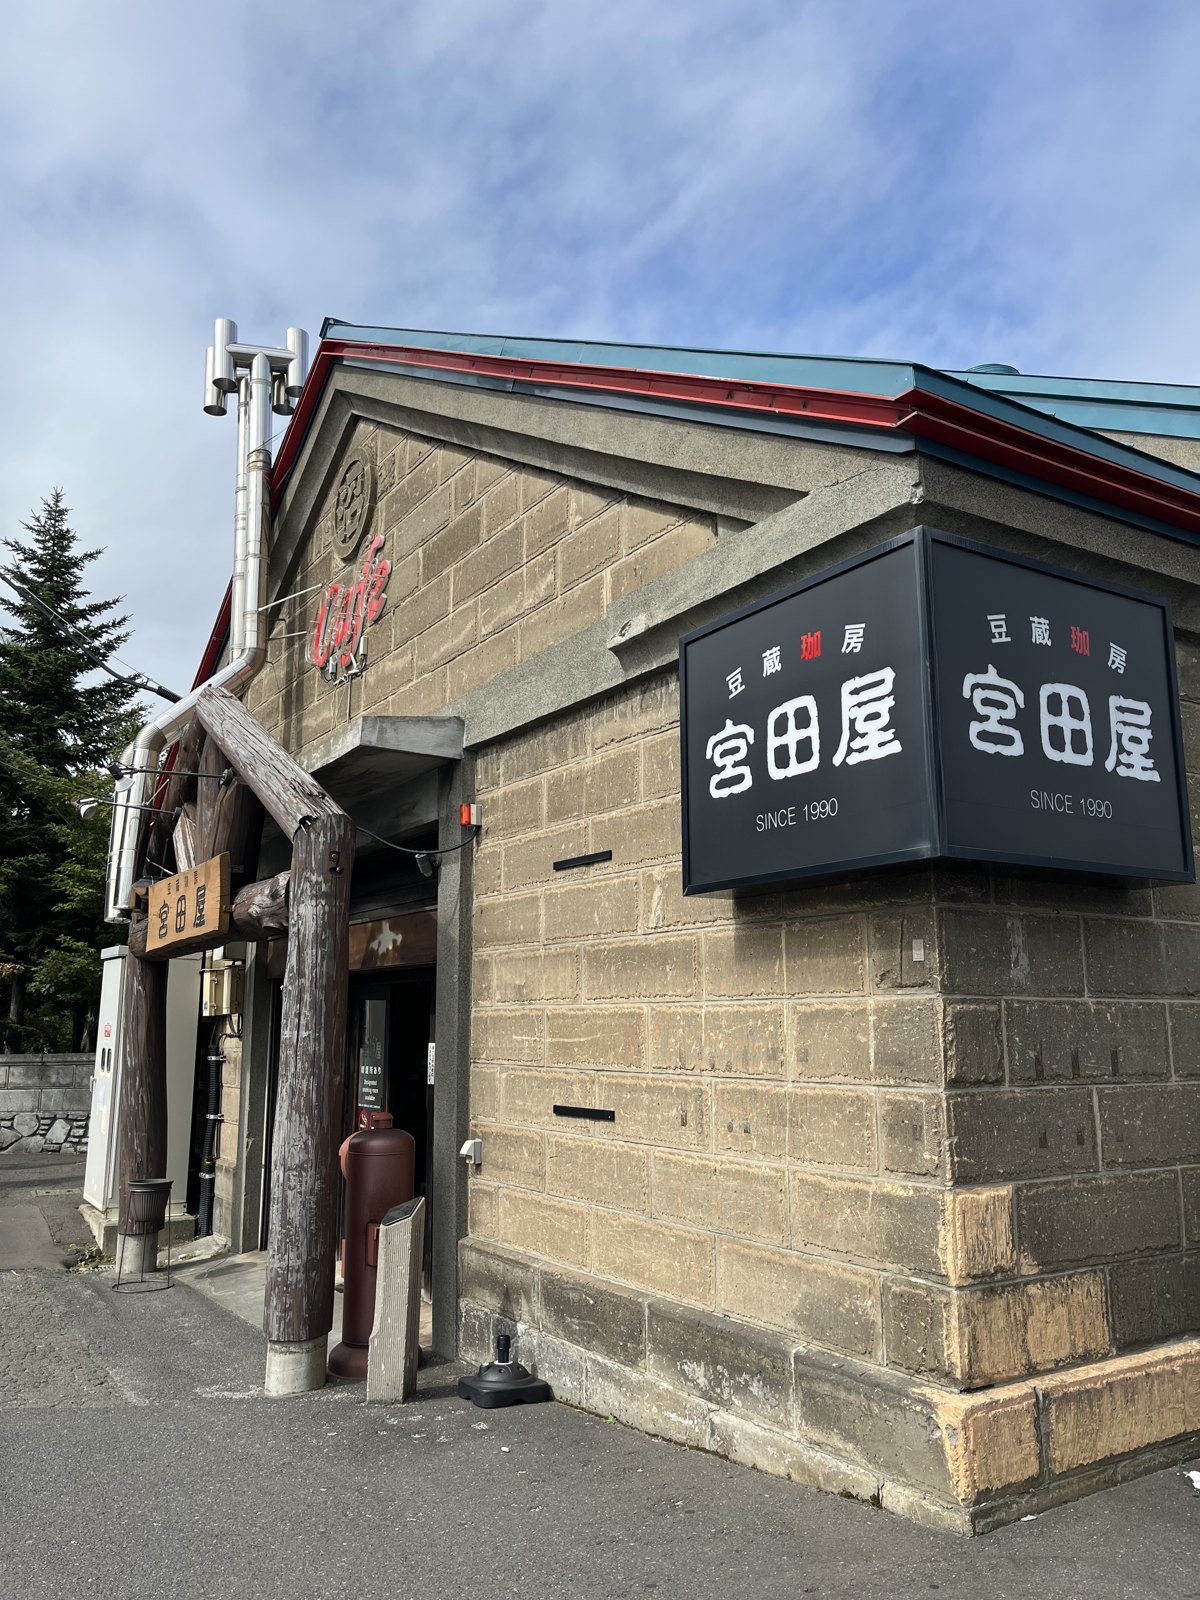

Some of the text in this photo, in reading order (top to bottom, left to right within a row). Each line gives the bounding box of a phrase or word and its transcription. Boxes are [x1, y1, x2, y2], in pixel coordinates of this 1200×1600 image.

[725, 622, 867, 700] 豆蔵珈房
[986, 613, 1129, 675] 豆蔵珈房
[705, 666, 903, 800] 宮田屋
[962, 663, 1162, 783] 宮田屋
[756, 797, 839, 832] SINCE 1990
[1030, 789, 1113, 819] SINCE 1990
[159, 884, 206, 939] 宮田屋
